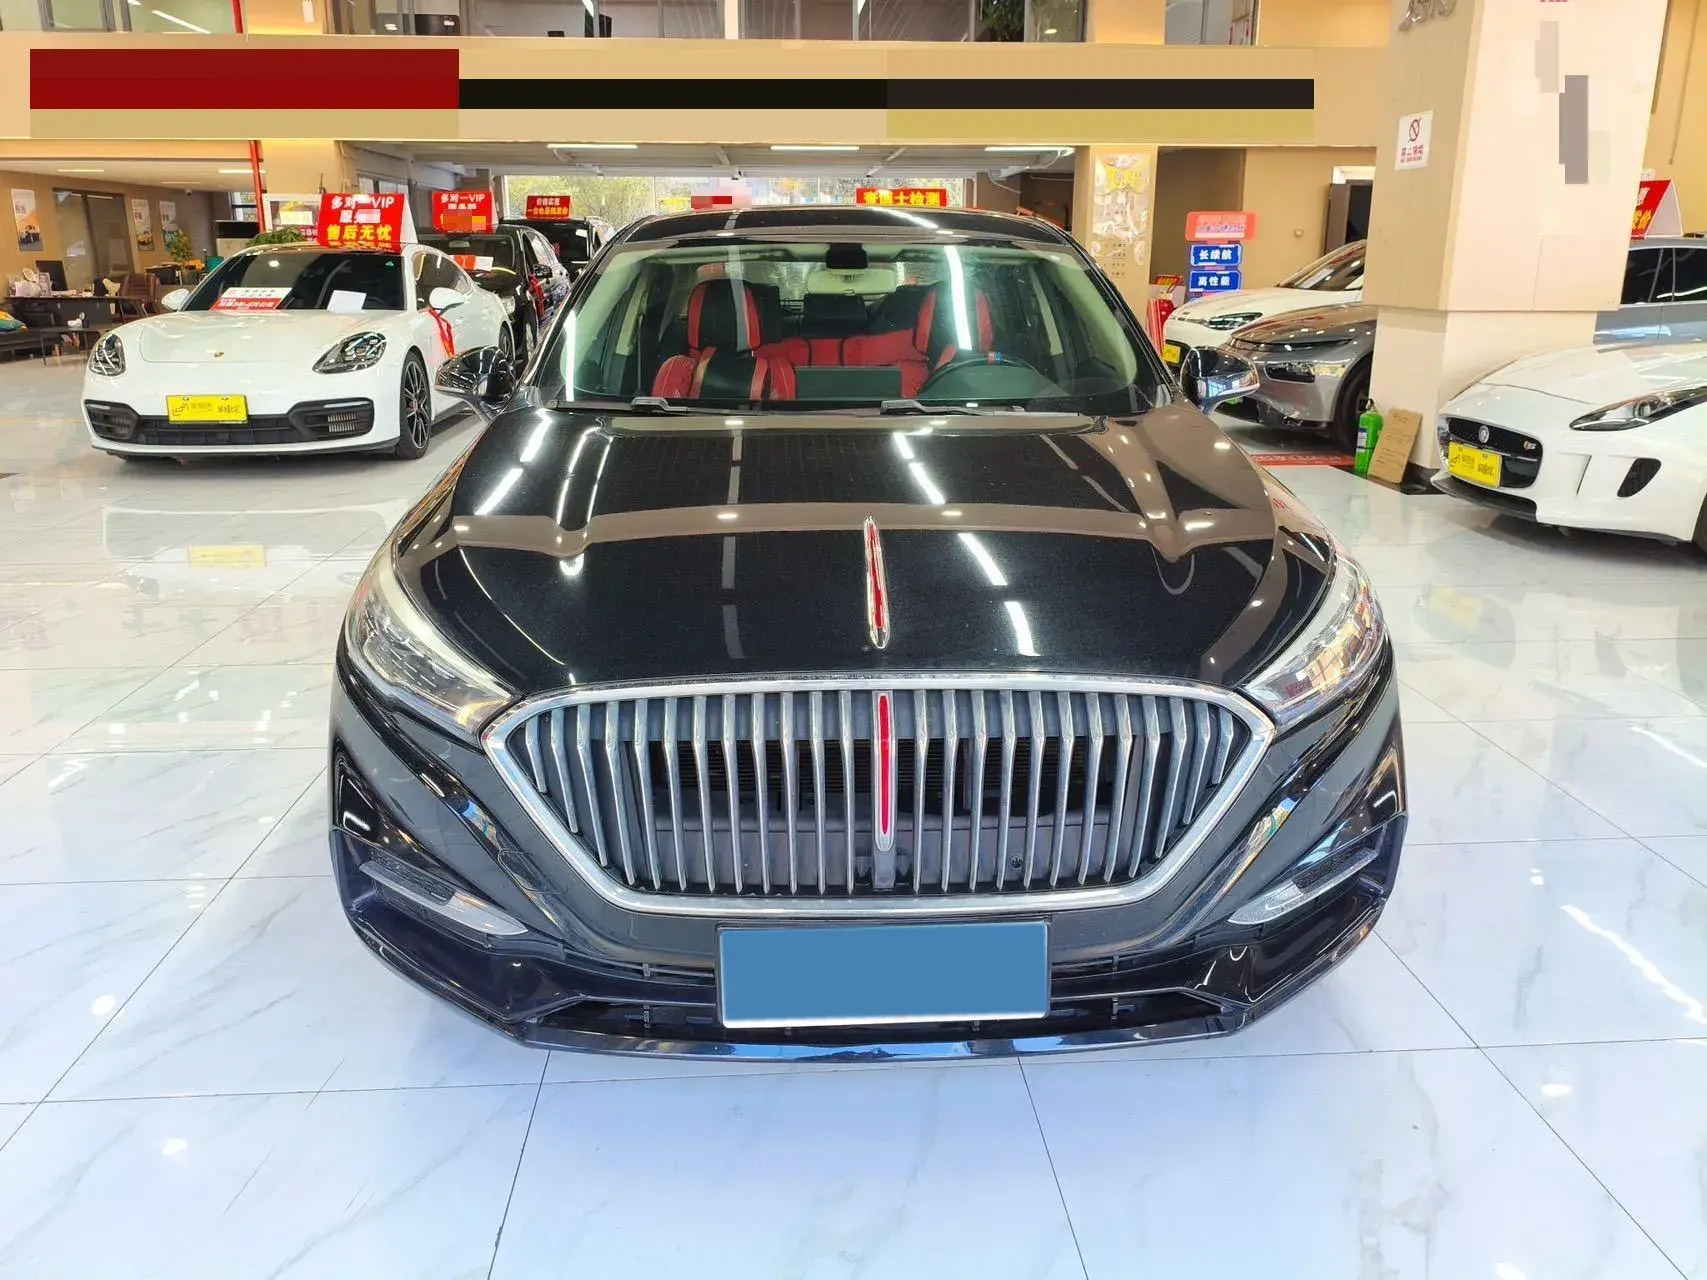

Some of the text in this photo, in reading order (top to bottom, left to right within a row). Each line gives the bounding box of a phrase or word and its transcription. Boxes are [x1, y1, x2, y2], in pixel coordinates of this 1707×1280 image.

[327, 224, 392, 240] 售后无忧
[1198, 249, 1232, 260] 长续航
[1197, 276, 1230, 287] 高性能
